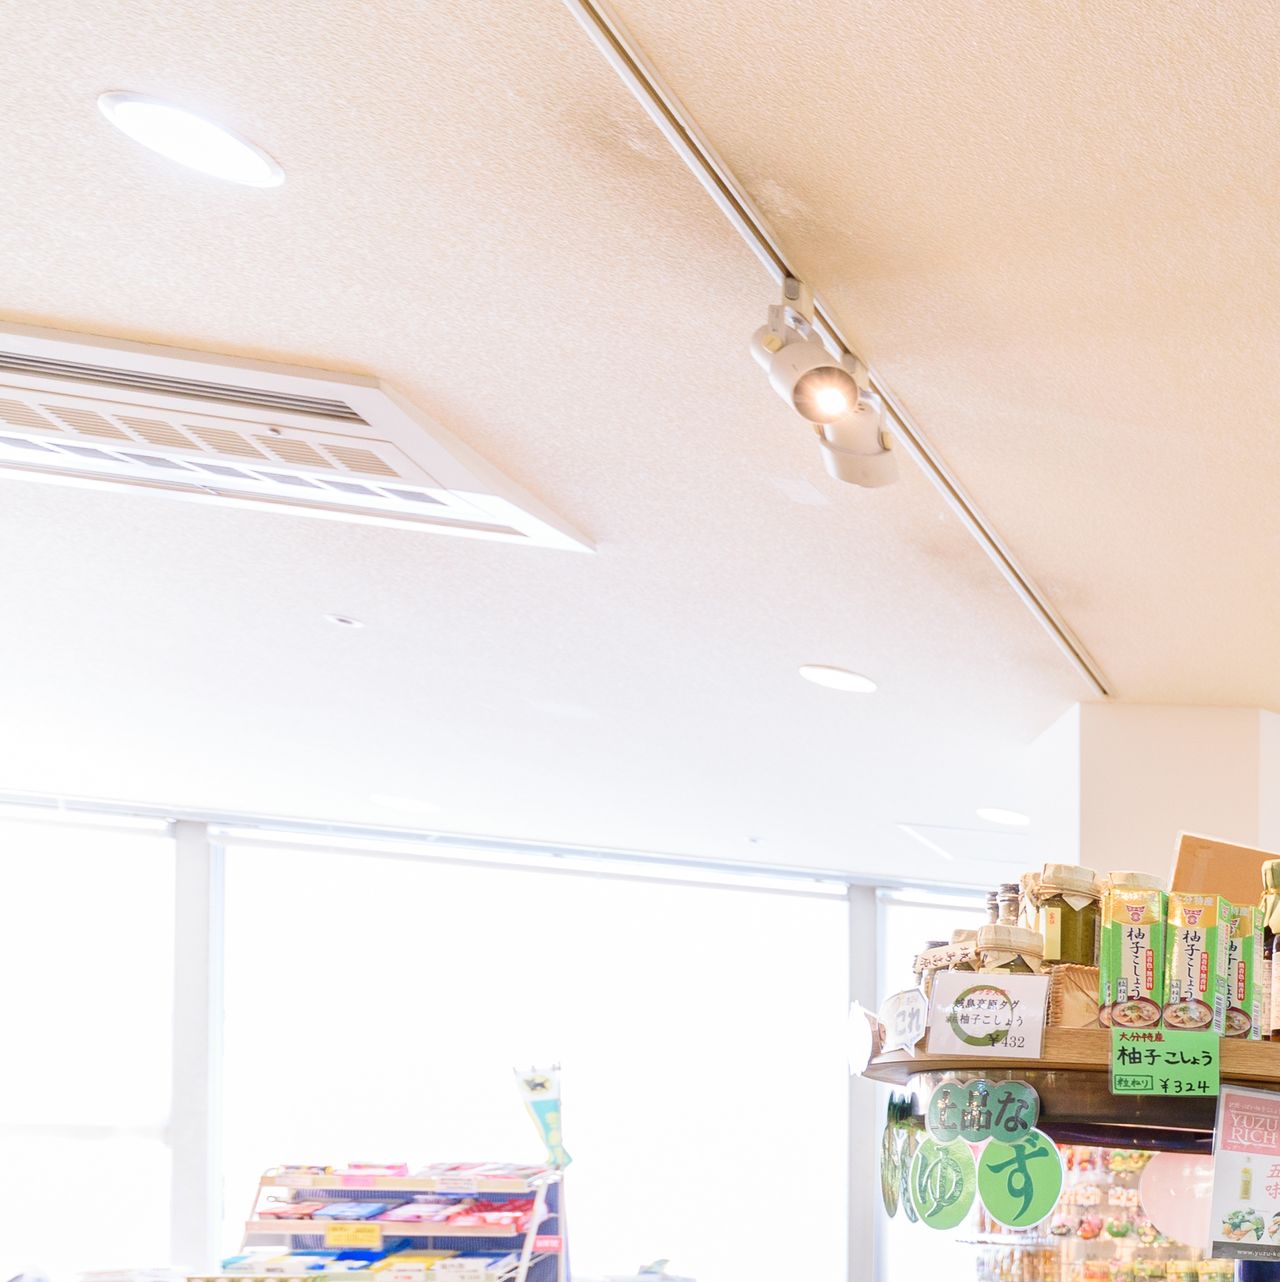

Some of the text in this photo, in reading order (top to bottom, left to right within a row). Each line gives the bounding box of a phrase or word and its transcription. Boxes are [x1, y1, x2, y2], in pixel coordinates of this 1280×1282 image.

[1127, 927, 1146, 1000] 柚子こしょう
[1182, 930, 1201, 1001] 柚子こしょう
[988, 1033, 1026, 1048] ¥432
[1119, 1031, 1165, 1042] 大分特産
[1117, 1046, 1213, 1066] 柚子こしょう
[1116, 1076, 1210, 1094] 粒ねり ¥324
[1231, 1112, 1279, 1131] YUZU
[1231, 1126, 1278, 1145] RICH
